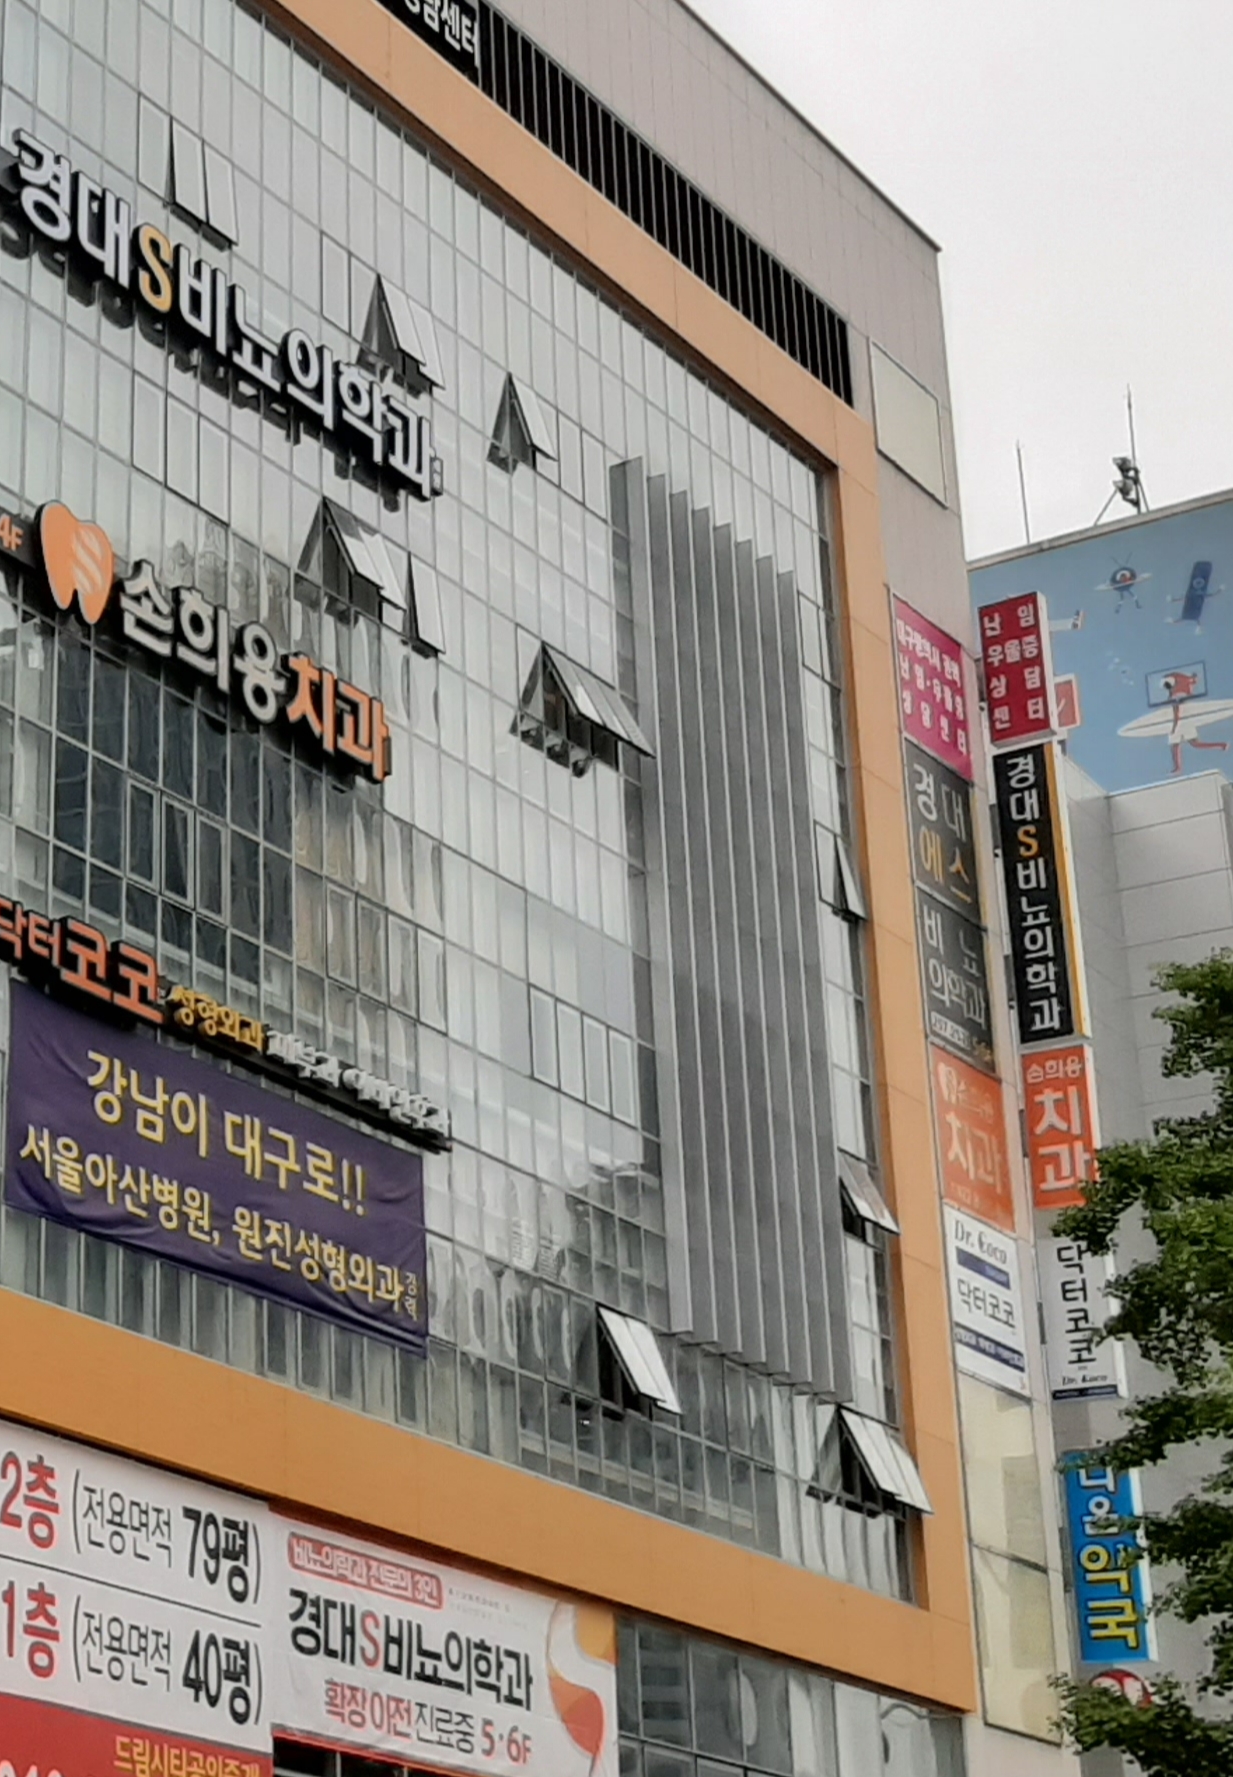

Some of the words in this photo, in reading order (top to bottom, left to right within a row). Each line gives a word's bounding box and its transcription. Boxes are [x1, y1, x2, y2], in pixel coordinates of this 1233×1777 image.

[404, 0, 479, 67] 담센터
[16, 128, 436, 500] 경대S비뇨의학과
[913, 763, 966, 843] 경대
[1007, 753, 1061, 1032] 경대S비뇨의학과
[168, 984, 265, 1053] 성형외과
[87, 1050, 209, 1158] 강남이
[224, 1111, 366, 1216] 대구로!!
[945, 1111, 1001, 1194] 치과
[1033, 1085, 1091, 1191] 치과
[20, 1124, 221, 1248] 서울아산병원,
[233, 1206, 404, 1313] 원진성형외과
[957, 1278, 1016, 1329] 닥터코코
[1057, 1244, 1097, 1365] 닥터코코
[72, 1468, 173, 1570] (전용면적
[182, 1506, 262, 1604] 79평)
[2, 1579, 60, 1680] 1층
[72, 1594, 171, 1693] (전용면적
[181, 1629, 263, 1726] 40평)
[288, 1588, 534, 1712] 경대S비뇨의학과
[414, 1701, 476, 1755] 진료중
